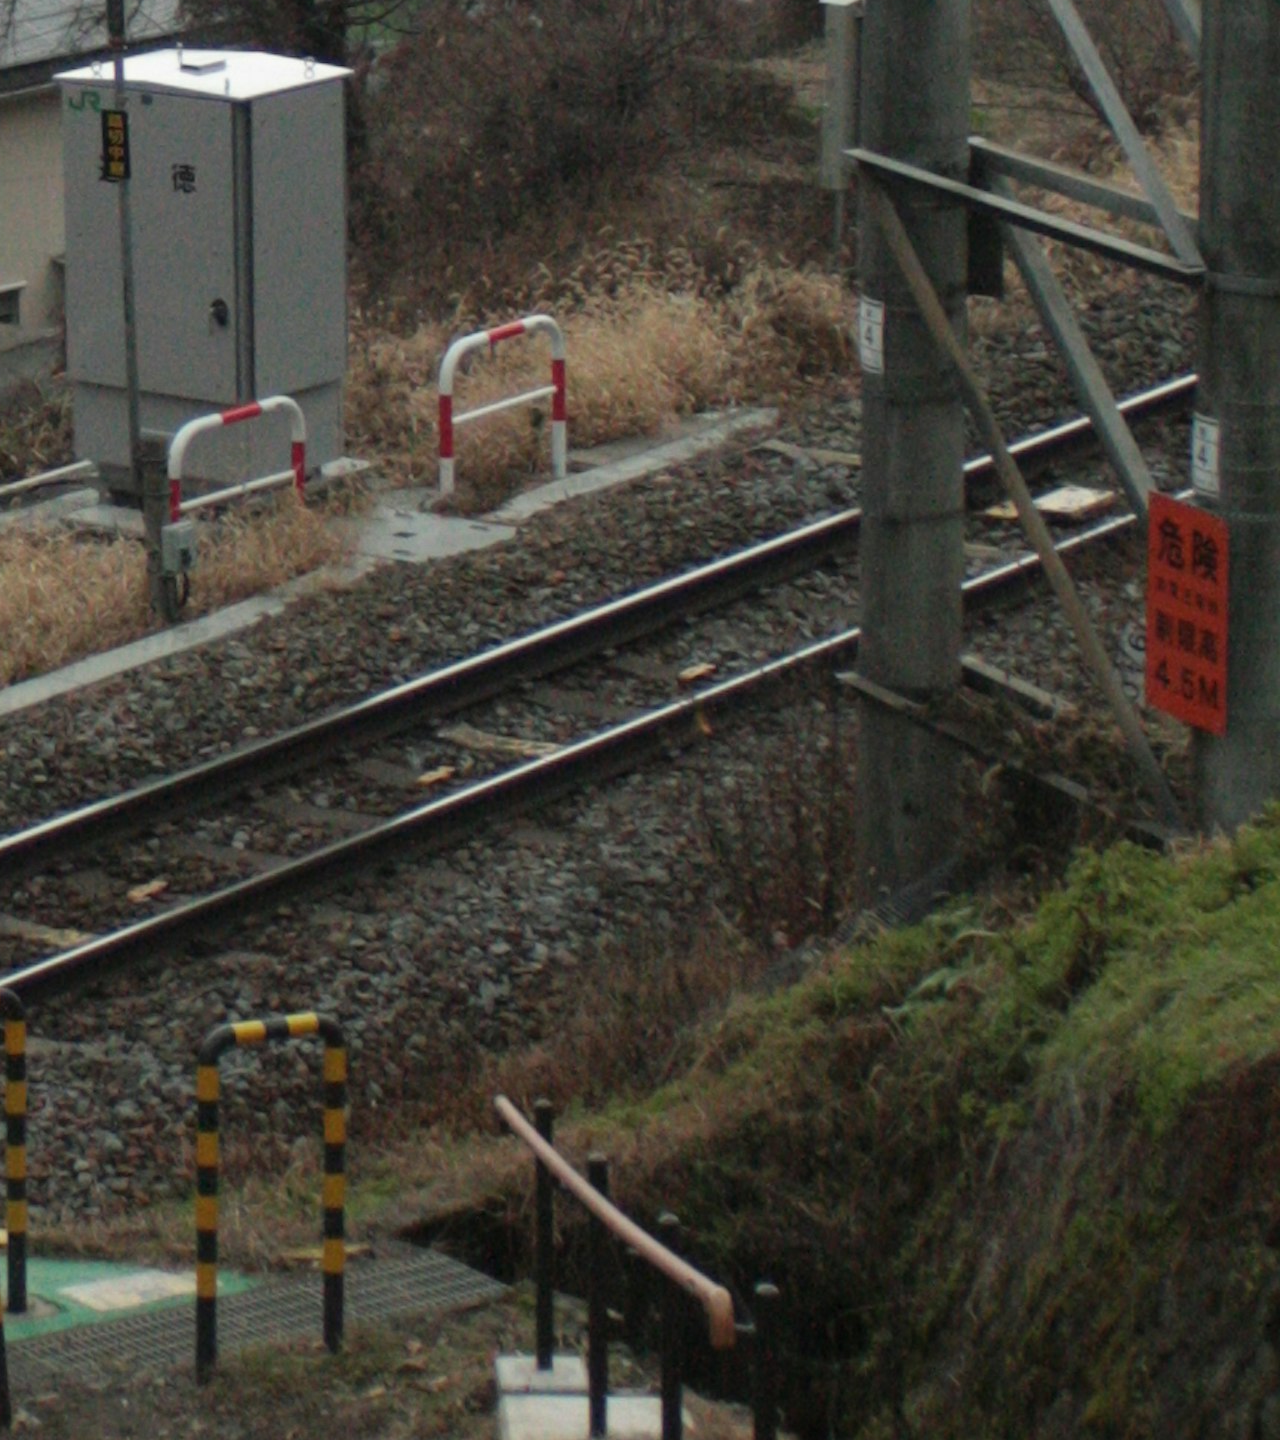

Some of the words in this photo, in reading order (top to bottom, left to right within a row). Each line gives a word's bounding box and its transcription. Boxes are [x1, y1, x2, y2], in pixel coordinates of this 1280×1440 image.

[68, 90, 102, 112] JR
[172, 163, 197, 193] 徳
[1158, 517, 1219, 584] 危険
